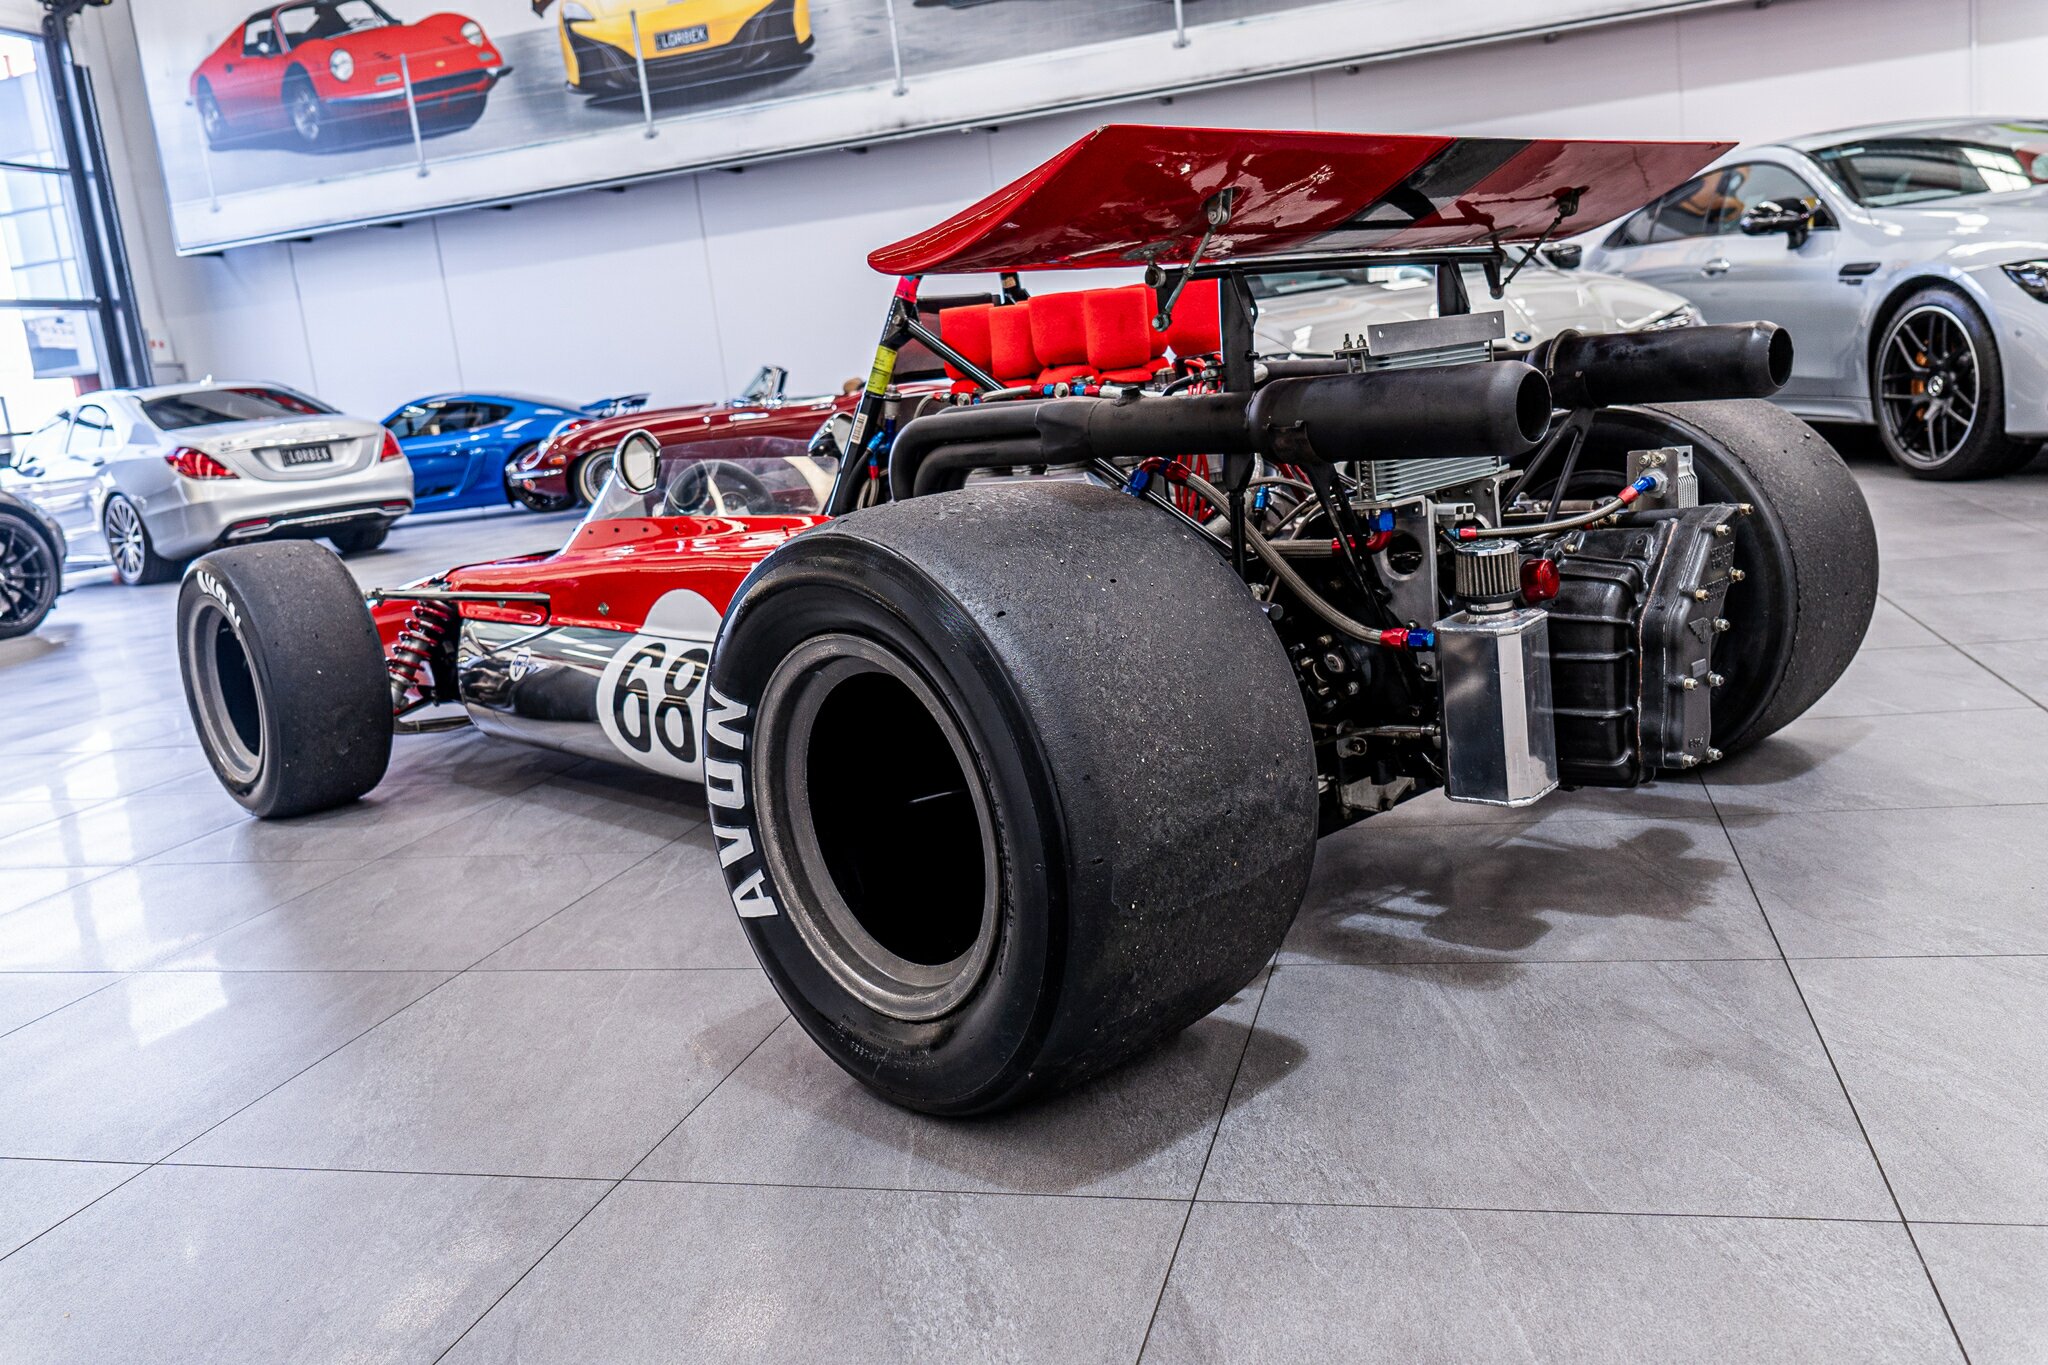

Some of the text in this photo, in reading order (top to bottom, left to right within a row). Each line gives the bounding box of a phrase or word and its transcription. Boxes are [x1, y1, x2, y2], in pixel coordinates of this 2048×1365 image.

[661, 26, 708, 48] LORBEK
[288, 447, 330, 463] LORBEK
[612, 642, 709, 763] 68
[705, 683, 779, 918] AVON
